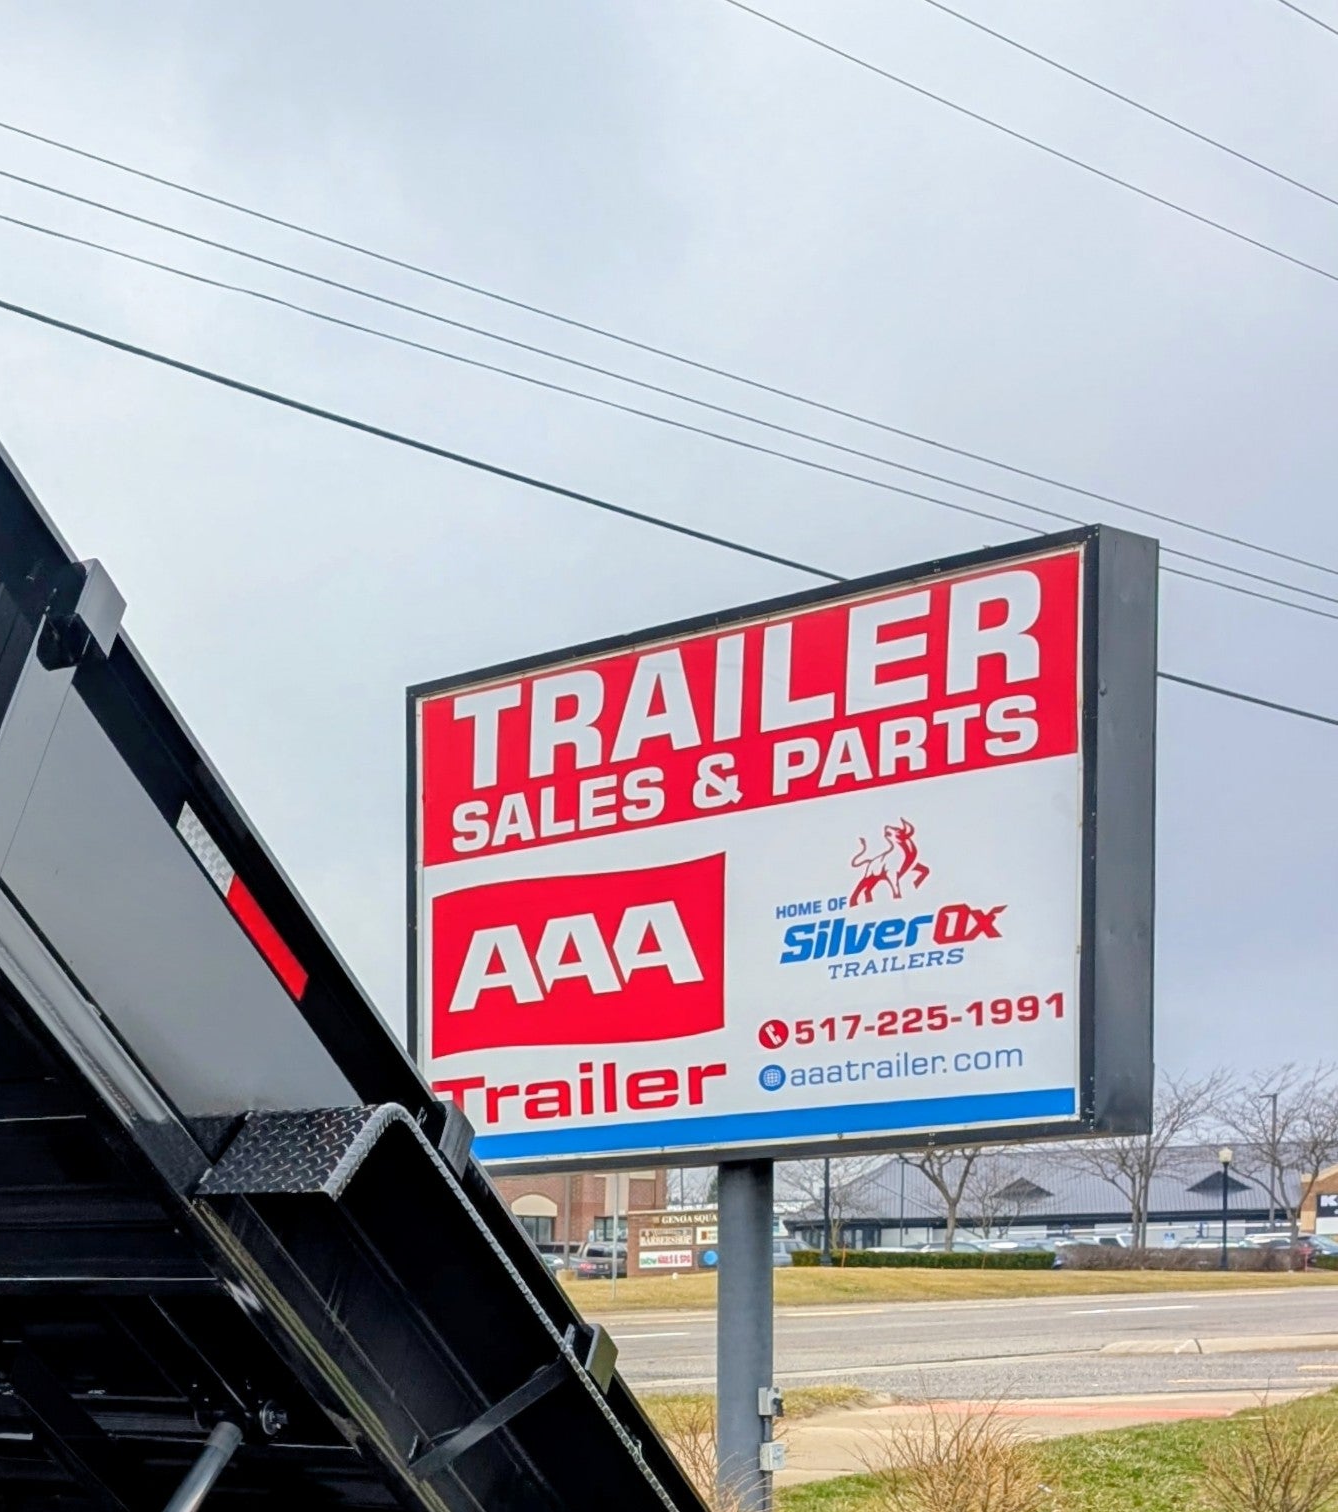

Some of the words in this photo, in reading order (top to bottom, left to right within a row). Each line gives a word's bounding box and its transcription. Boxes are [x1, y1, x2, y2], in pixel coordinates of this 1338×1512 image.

[453, 570, 1041, 790] TRAILER
[452, 766, 665, 852] SALES
[693, 752, 743, 809] &
[772, 695, 1039, 797] PARTS
[776, 899, 822, 919] HOME
[827, 896, 848, 911] OF
[448, 900, 705, 1013] AAA
[828, 948, 964, 980] TRAILERS
[795, 992, 1064, 1045] 517-225-1991
[432, 1062, 726, 1124] Trailer
[790, 1047, 1024, 1087] aaatrailer.com
[661, 1214, 693, 1225] GENOA
[693, 1213, 717, 1224] SQUA
